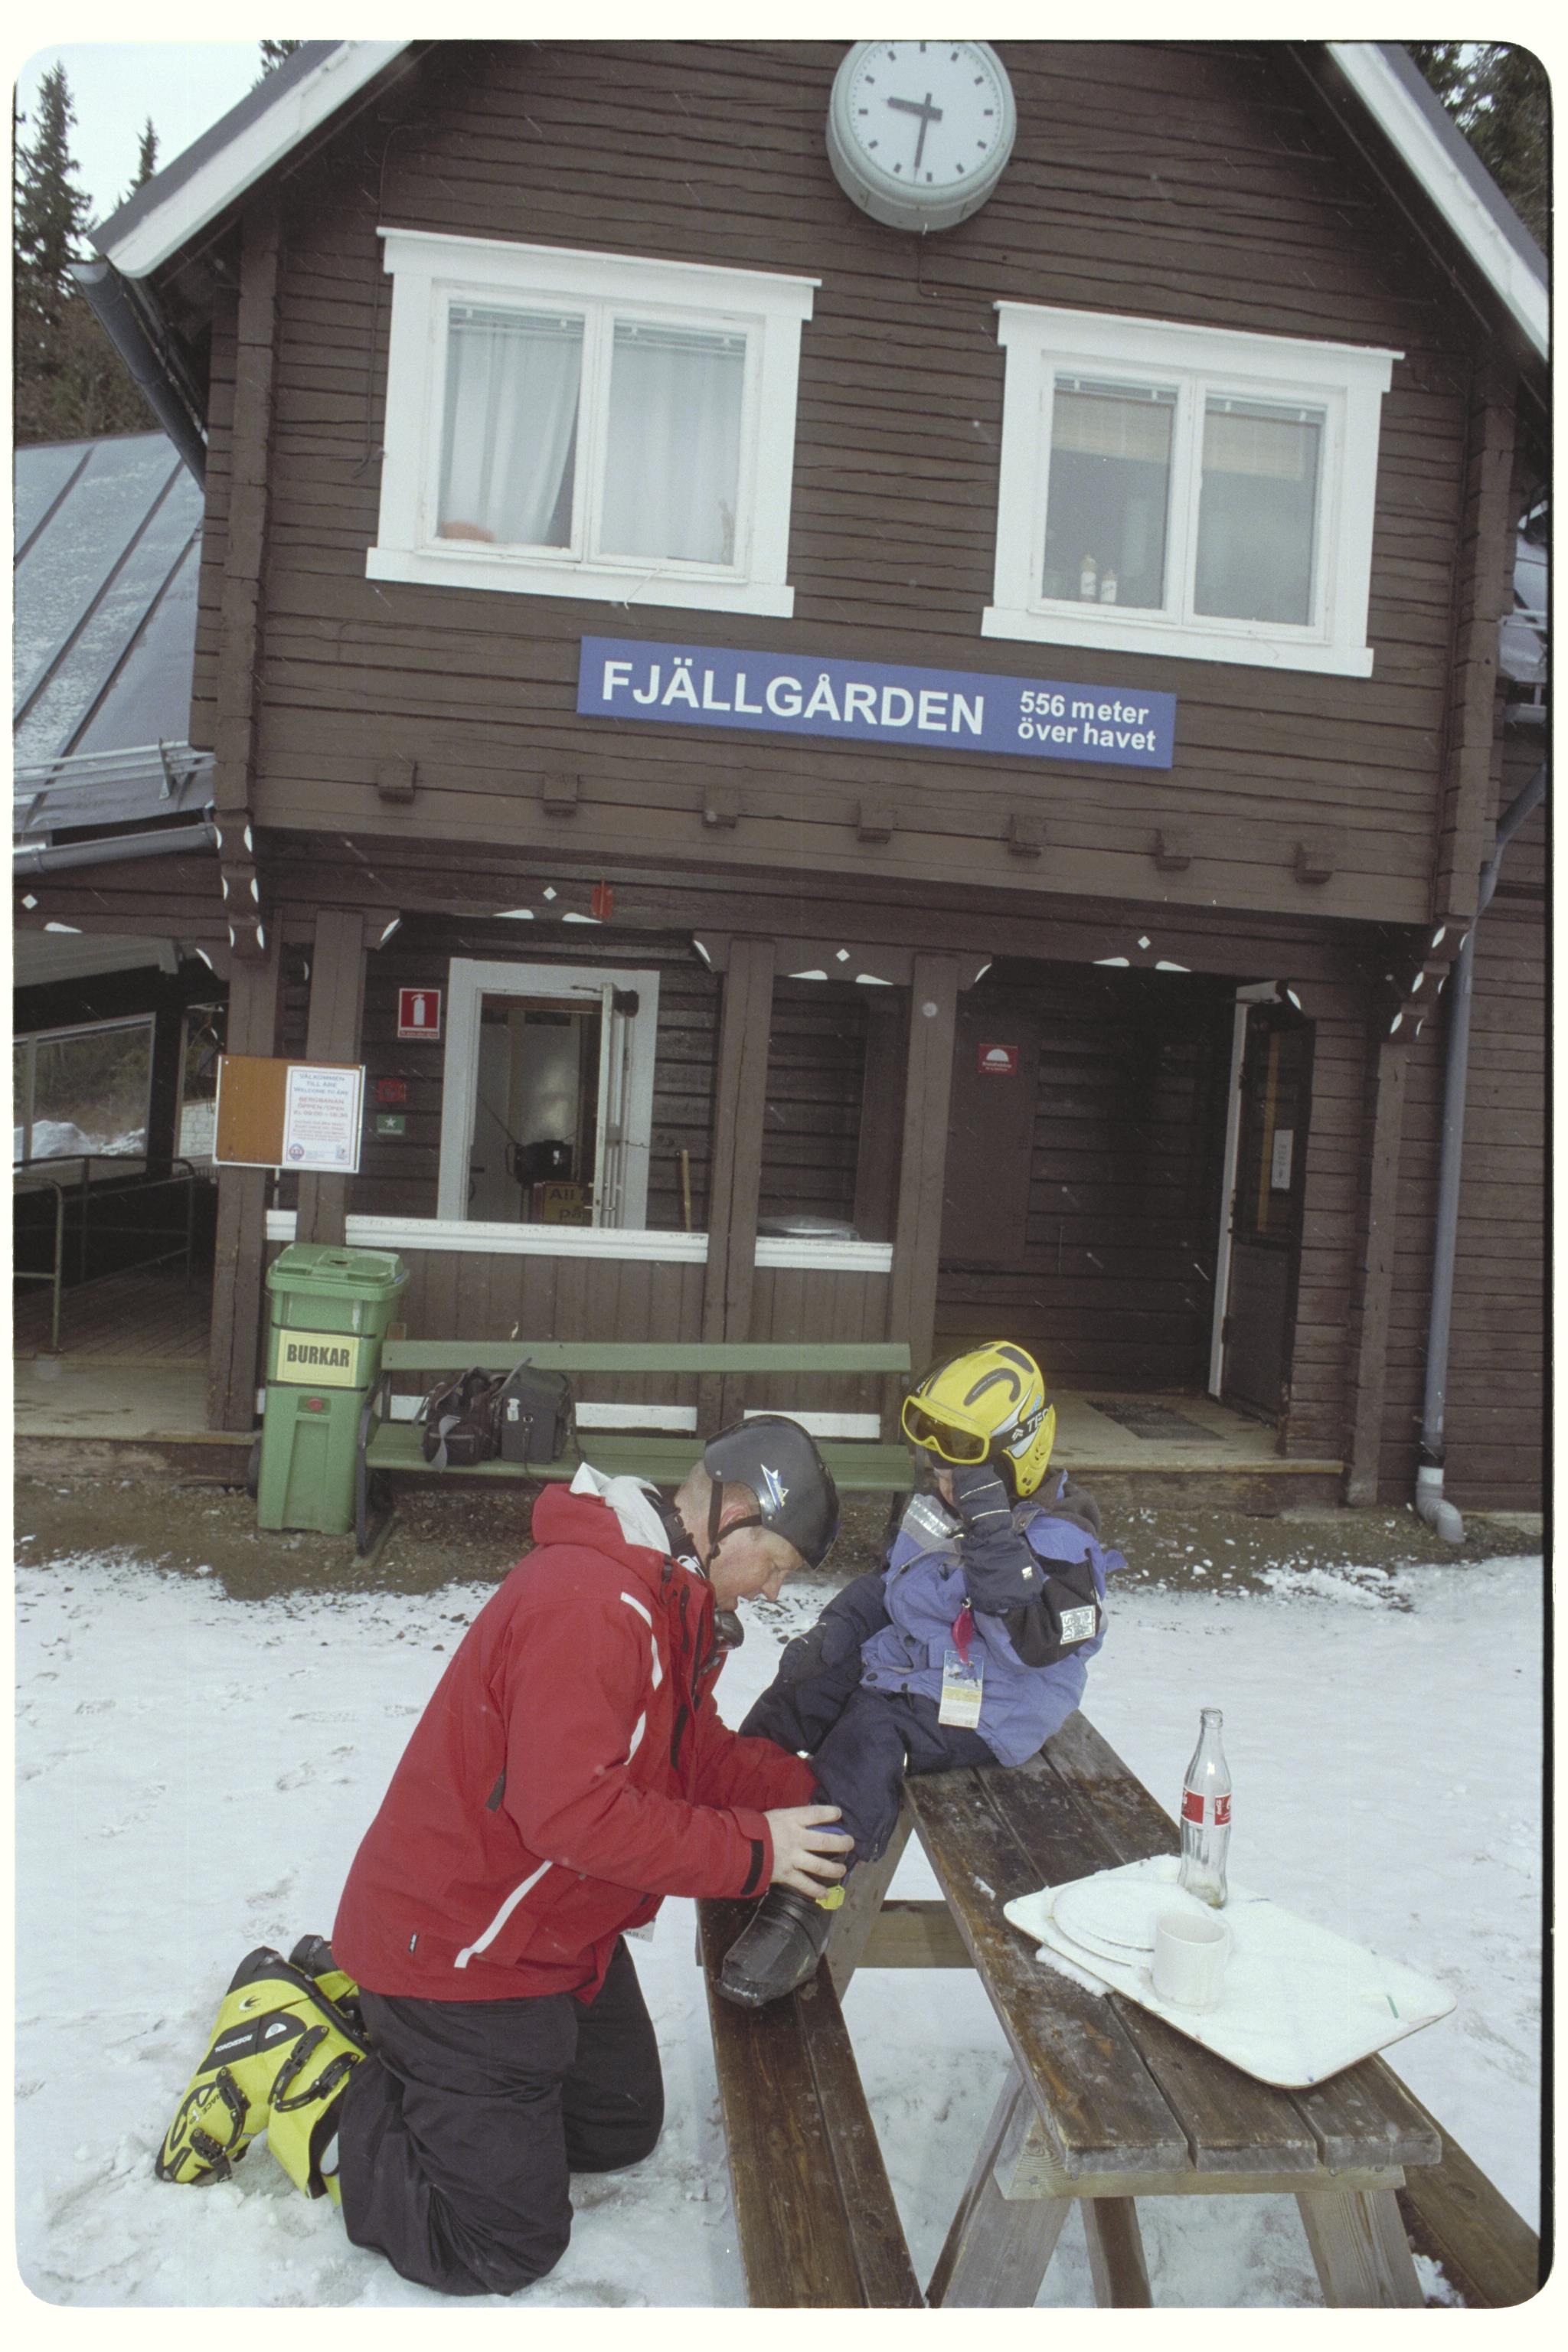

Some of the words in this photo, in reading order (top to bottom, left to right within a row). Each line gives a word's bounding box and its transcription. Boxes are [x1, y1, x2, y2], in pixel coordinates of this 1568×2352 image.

[603, 657, 984, 735] FJÄLLGÅRDEN
[1020, 691, 1066, 717] 556
[1072, 701, 1149, 725] meter
[1018, 717, 1078, 744] över
[1083, 722, 1156, 752] havet
[287, 1344, 350, 1368] BURKAR
